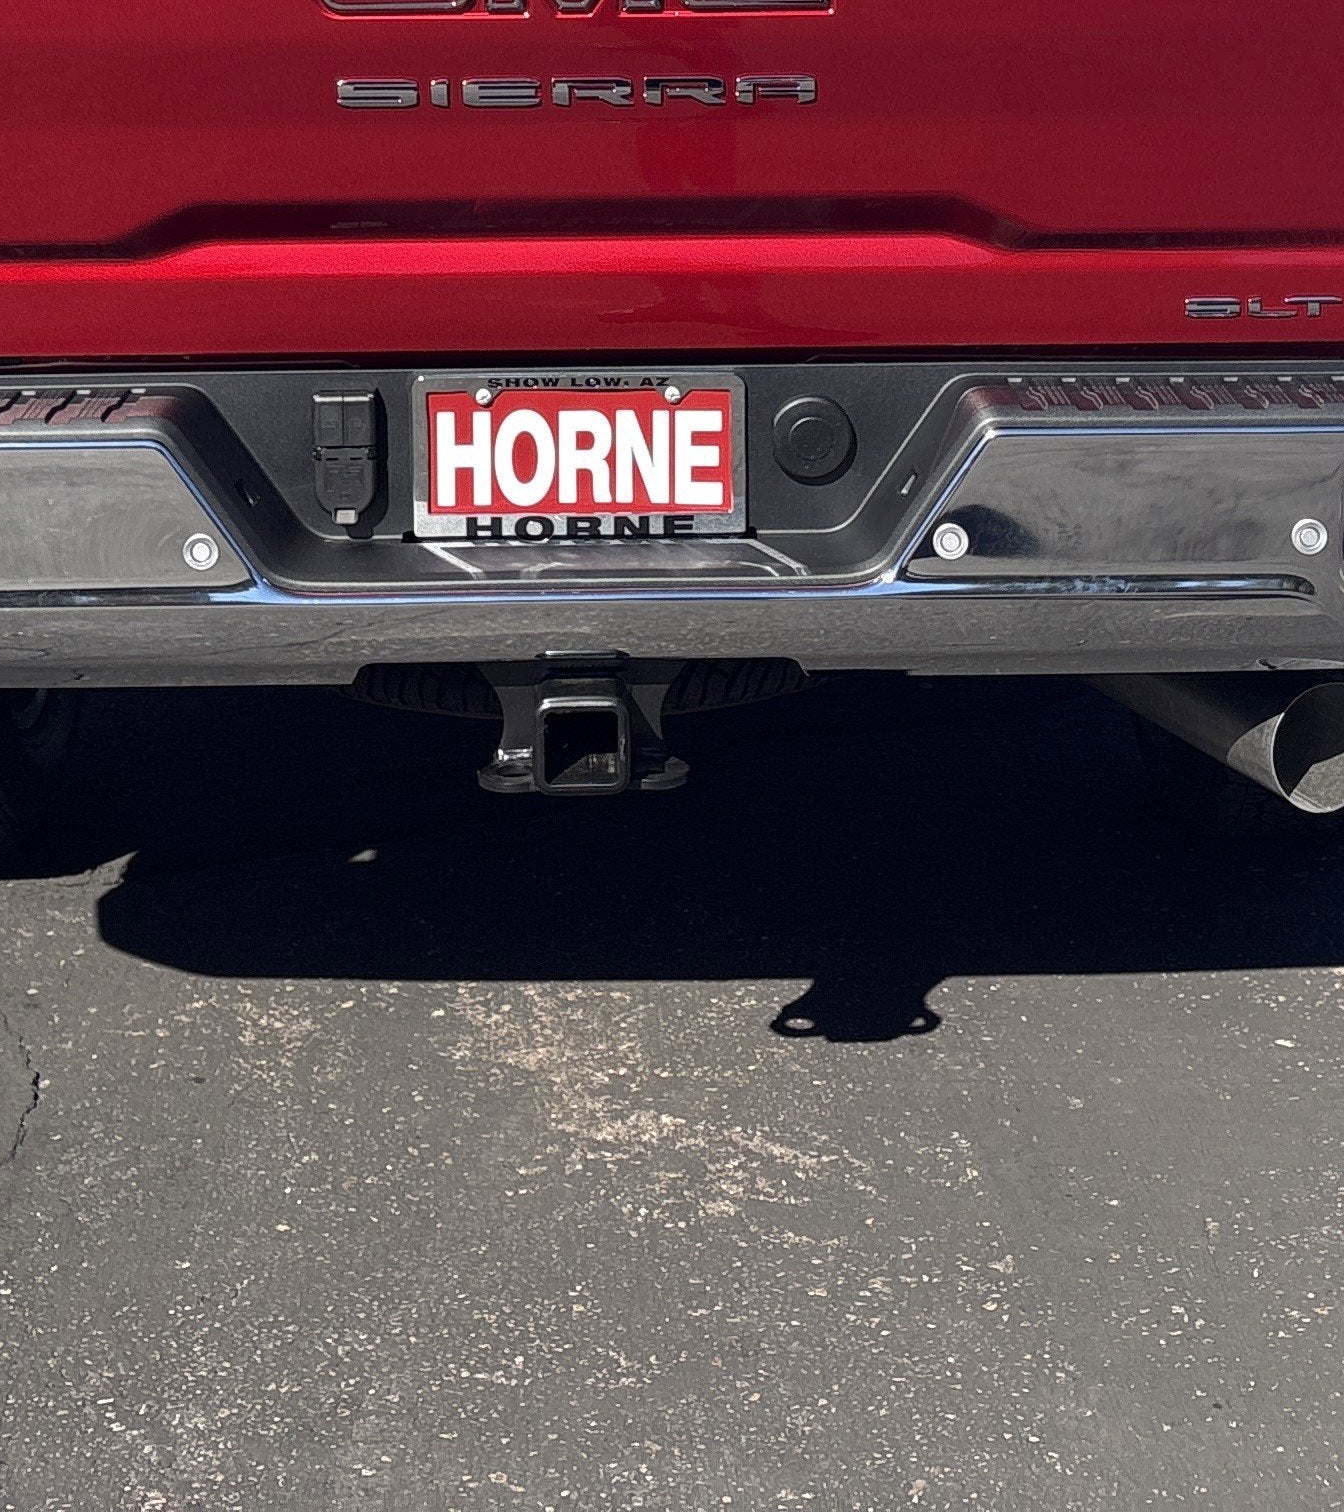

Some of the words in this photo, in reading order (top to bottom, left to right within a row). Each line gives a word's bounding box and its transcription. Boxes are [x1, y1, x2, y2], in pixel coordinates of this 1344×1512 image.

[336, 75, 817, 108] SIERRA
[1184, 295, 1344, 318] SLT
[487, 377, 560, 389] SHOW
[639, 377, 670, 387] AZ
[435, 409, 724, 507] HORNE
[464, 515, 695, 538] HORNE
